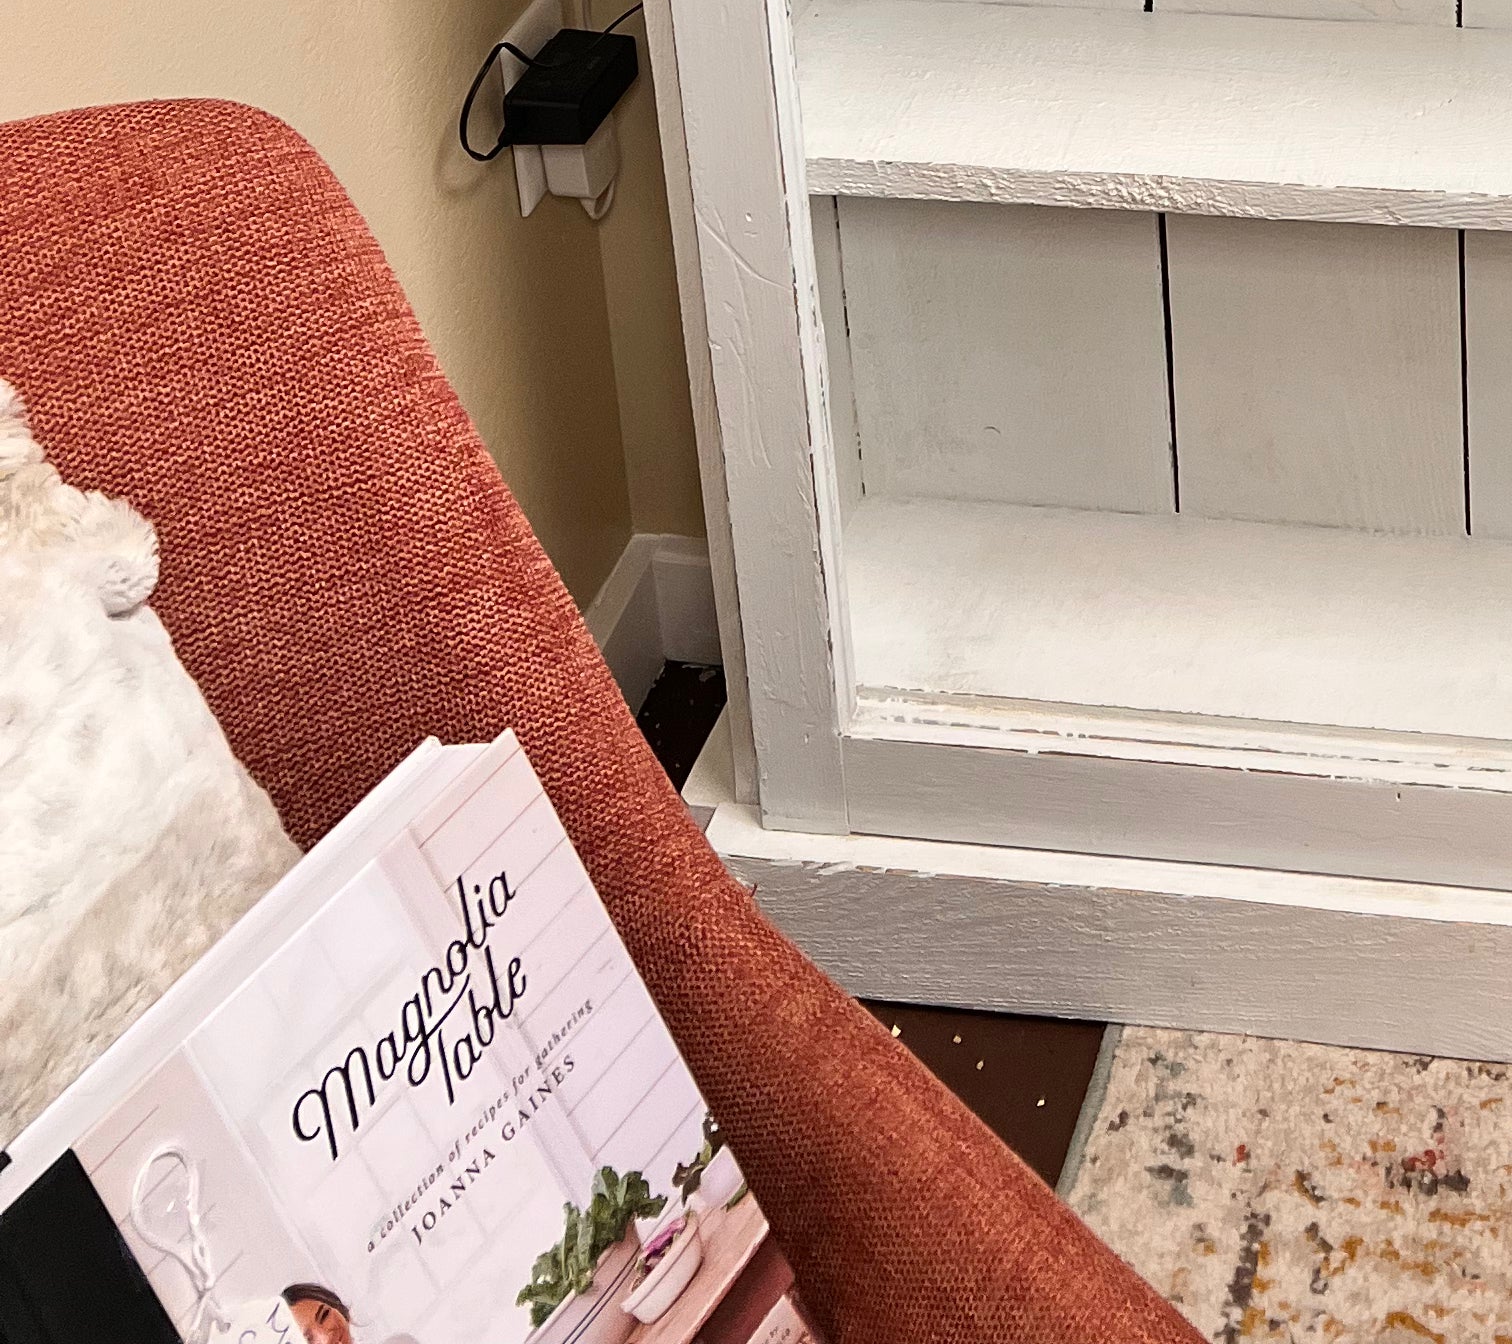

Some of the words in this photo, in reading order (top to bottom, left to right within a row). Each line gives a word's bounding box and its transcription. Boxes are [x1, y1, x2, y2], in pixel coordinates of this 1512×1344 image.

[292, 871, 517, 1161] Magnolia
[367, 1240, 375, 1253] a
[380, 1164, 444, 1239] collection
[448, 1141, 461, 1163] of
[465, 1093, 509, 1145] recipes
[511, 1065, 530, 1096] for
[535, 998, 594, 1070] gathering
[438, 945, 527, 1106] Table
[410, 1147, 496, 1246] JOANNA
[501, 1054, 576, 1142] GAINES
